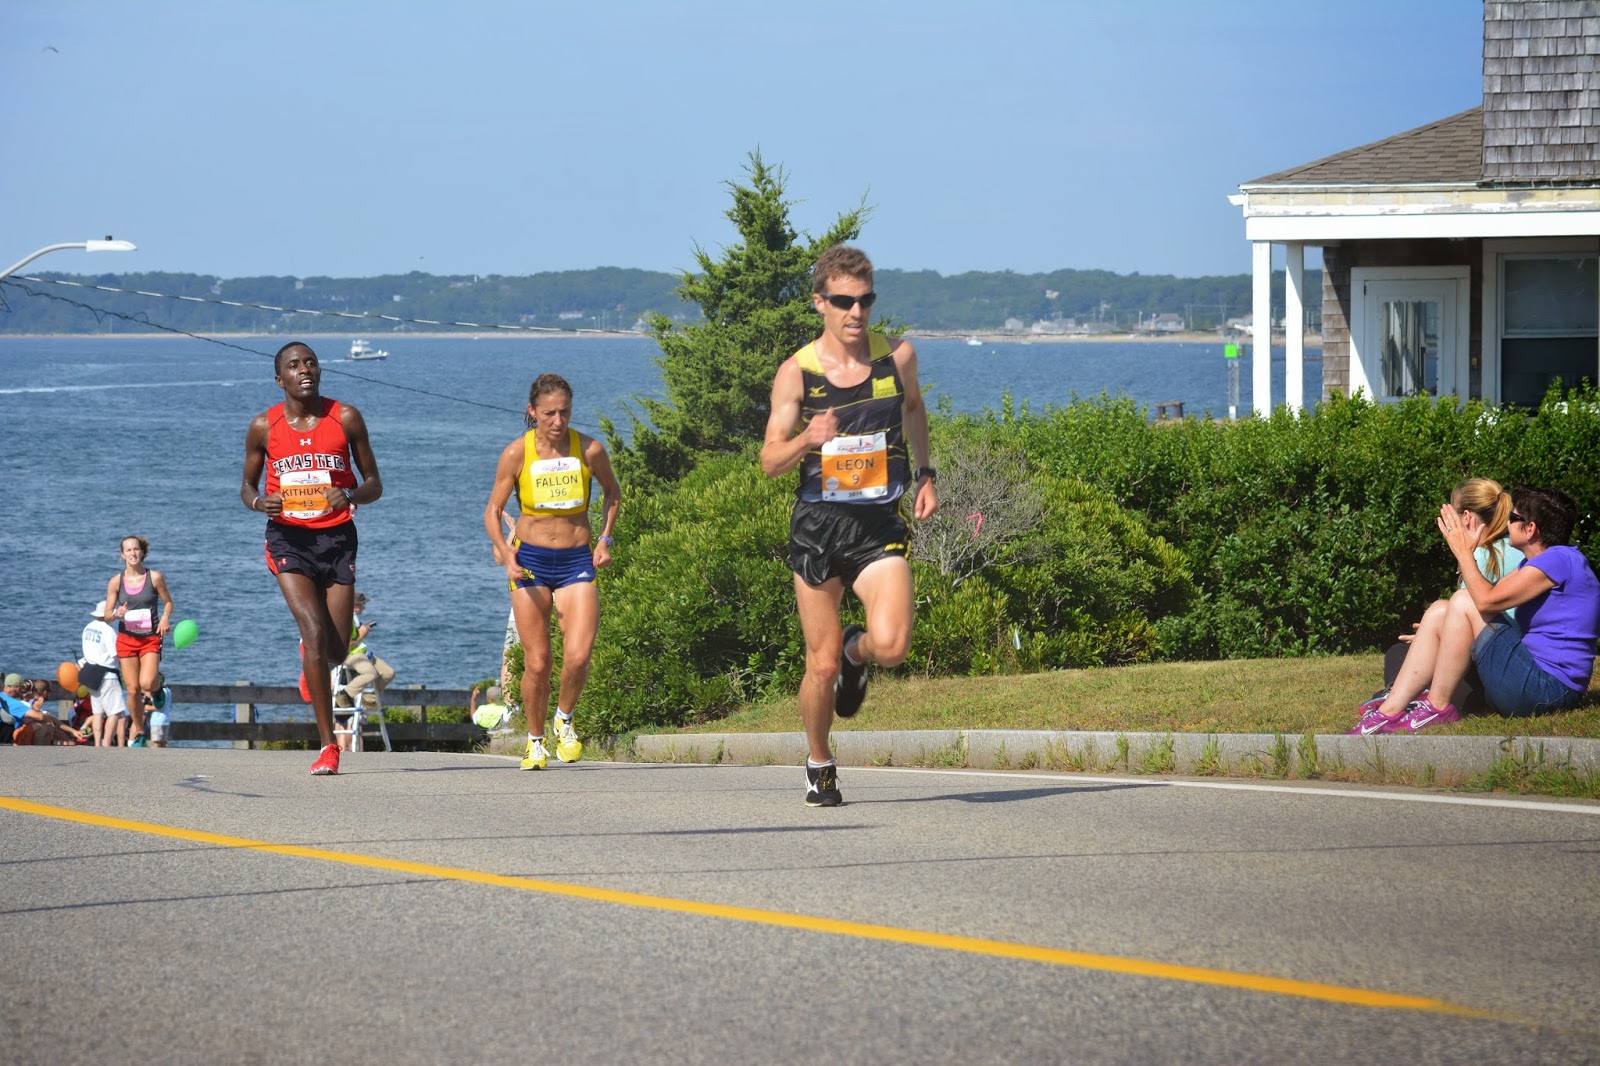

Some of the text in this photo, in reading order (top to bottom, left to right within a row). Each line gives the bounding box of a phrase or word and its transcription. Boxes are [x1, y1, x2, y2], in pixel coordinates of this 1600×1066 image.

[314, 453, 346, 472] TECH
[836, 458, 874, 470] LEON
[535, 475, 578, 487] FALLON
[852, 474, 860, 484] 9
[550, 488, 567, 498] 196
